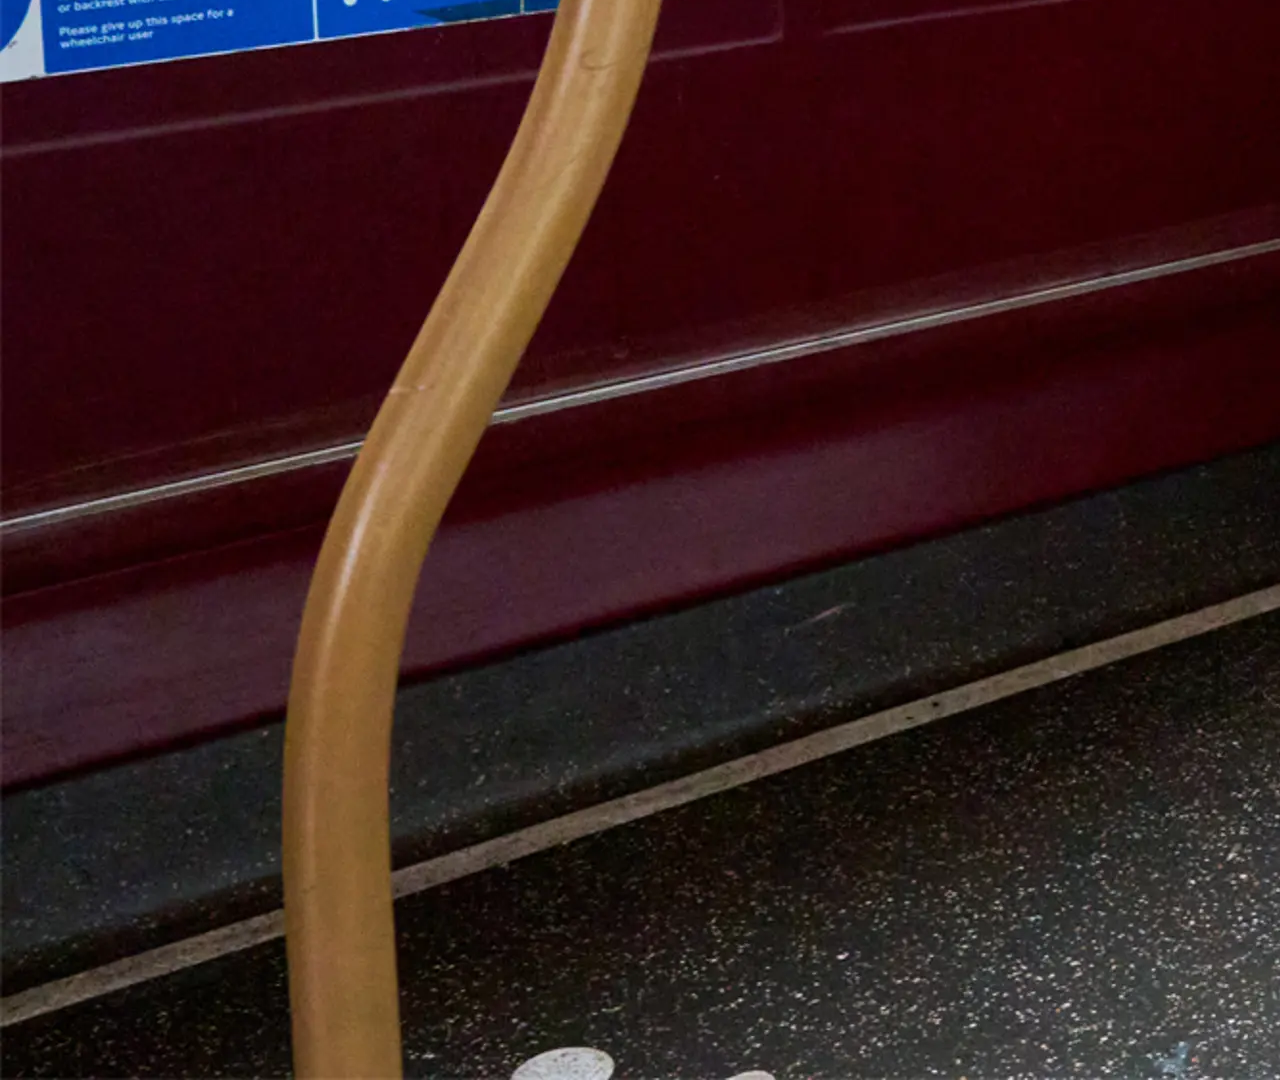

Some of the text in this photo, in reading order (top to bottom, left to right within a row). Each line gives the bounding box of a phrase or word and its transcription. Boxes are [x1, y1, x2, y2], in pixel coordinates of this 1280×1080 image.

[57, 4, 71, 14] or
[59, 9, 234, 37] Please give up this space for a
[60, 30, 154, 49] wheelchair user
